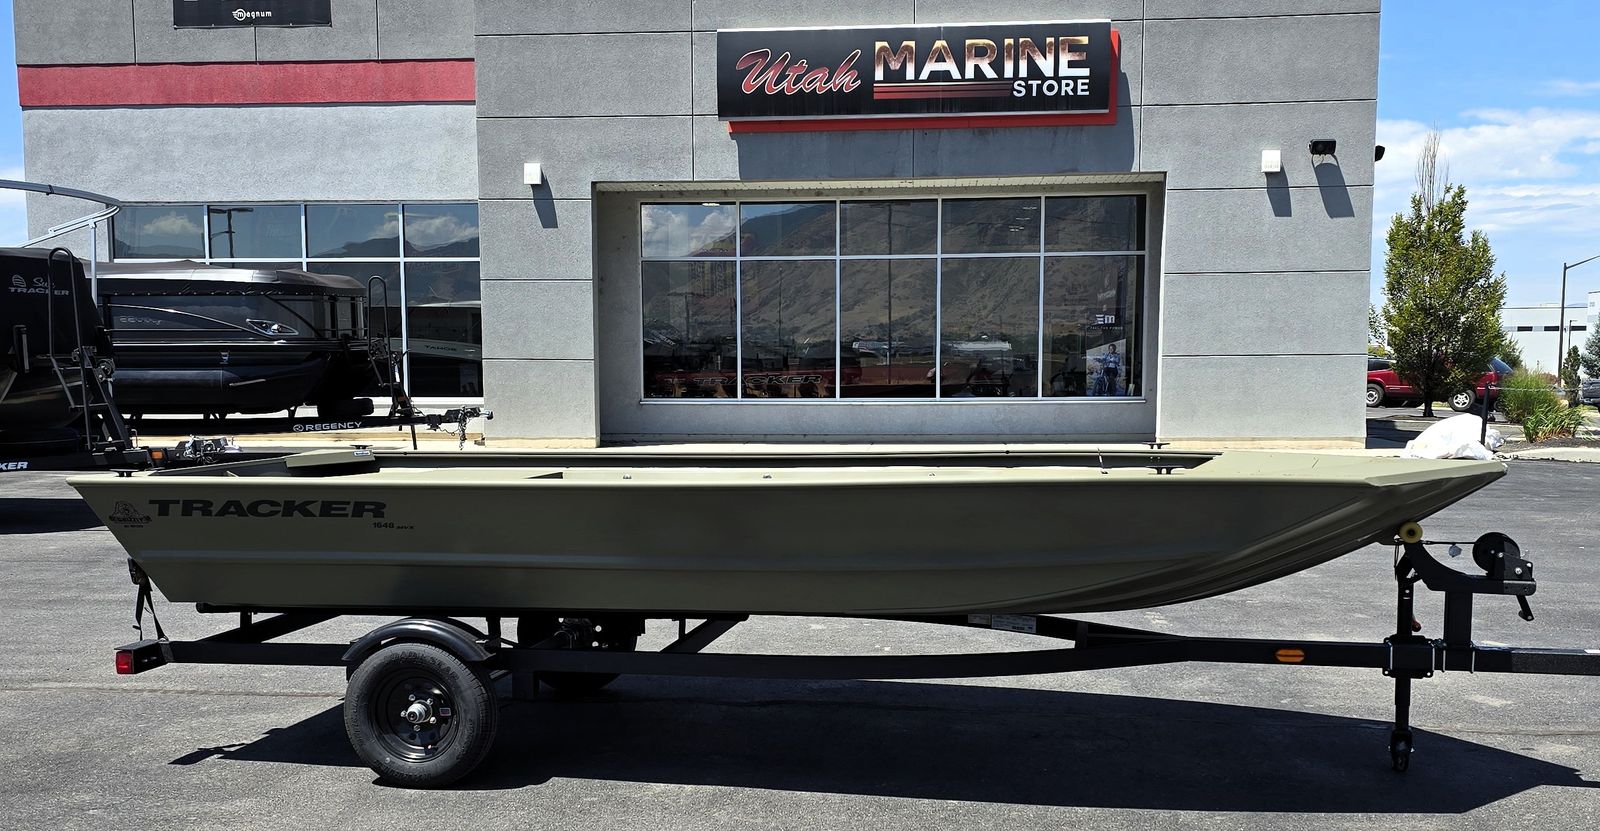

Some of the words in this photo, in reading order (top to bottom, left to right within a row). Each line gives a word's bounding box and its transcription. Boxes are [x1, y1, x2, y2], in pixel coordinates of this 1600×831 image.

[736, 48, 862, 95] Utah
[874, 36, 1090, 81] MARINE
[1012, 79, 1090, 97] STORE
[8, 287, 70, 296] TRACER
[305, 421, 362, 431] REGENCY
[148, 499, 387, 519] TRACKER
[372, 521, 395, 529] 1648
